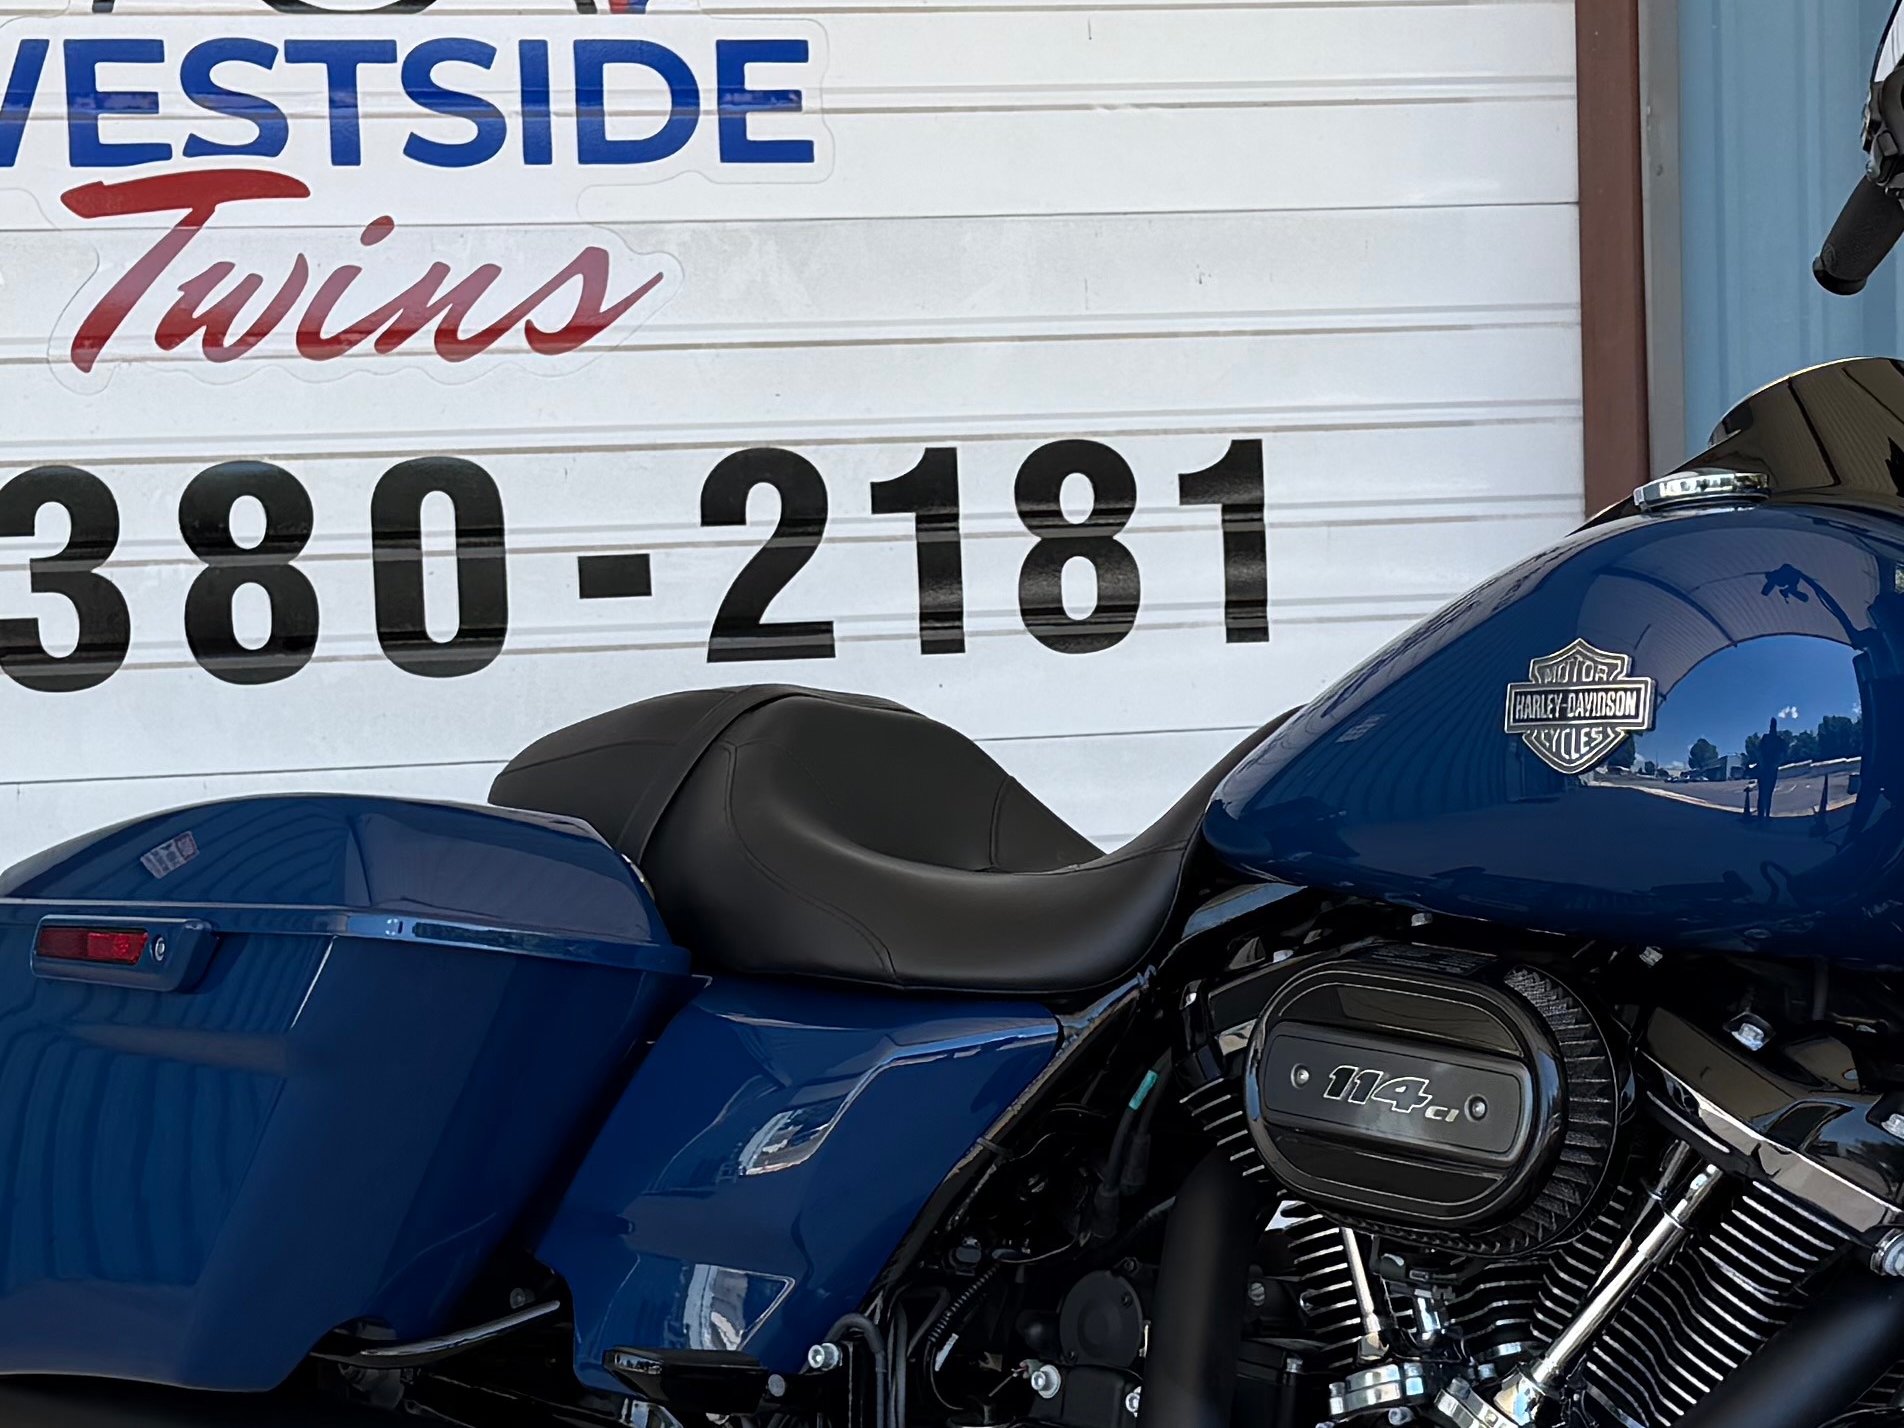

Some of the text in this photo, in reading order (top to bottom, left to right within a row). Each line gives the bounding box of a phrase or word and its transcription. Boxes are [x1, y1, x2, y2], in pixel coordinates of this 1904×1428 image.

[60, 167, 664, 373] Twins
[1544, 654, 1609, 684] MOTOR
[1515, 689, 1638, 721] HARLEY-DAVIDSON
[1539, 725, 1604, 761] CYCLES
[1322, 1064, 1433, 1114] 114
